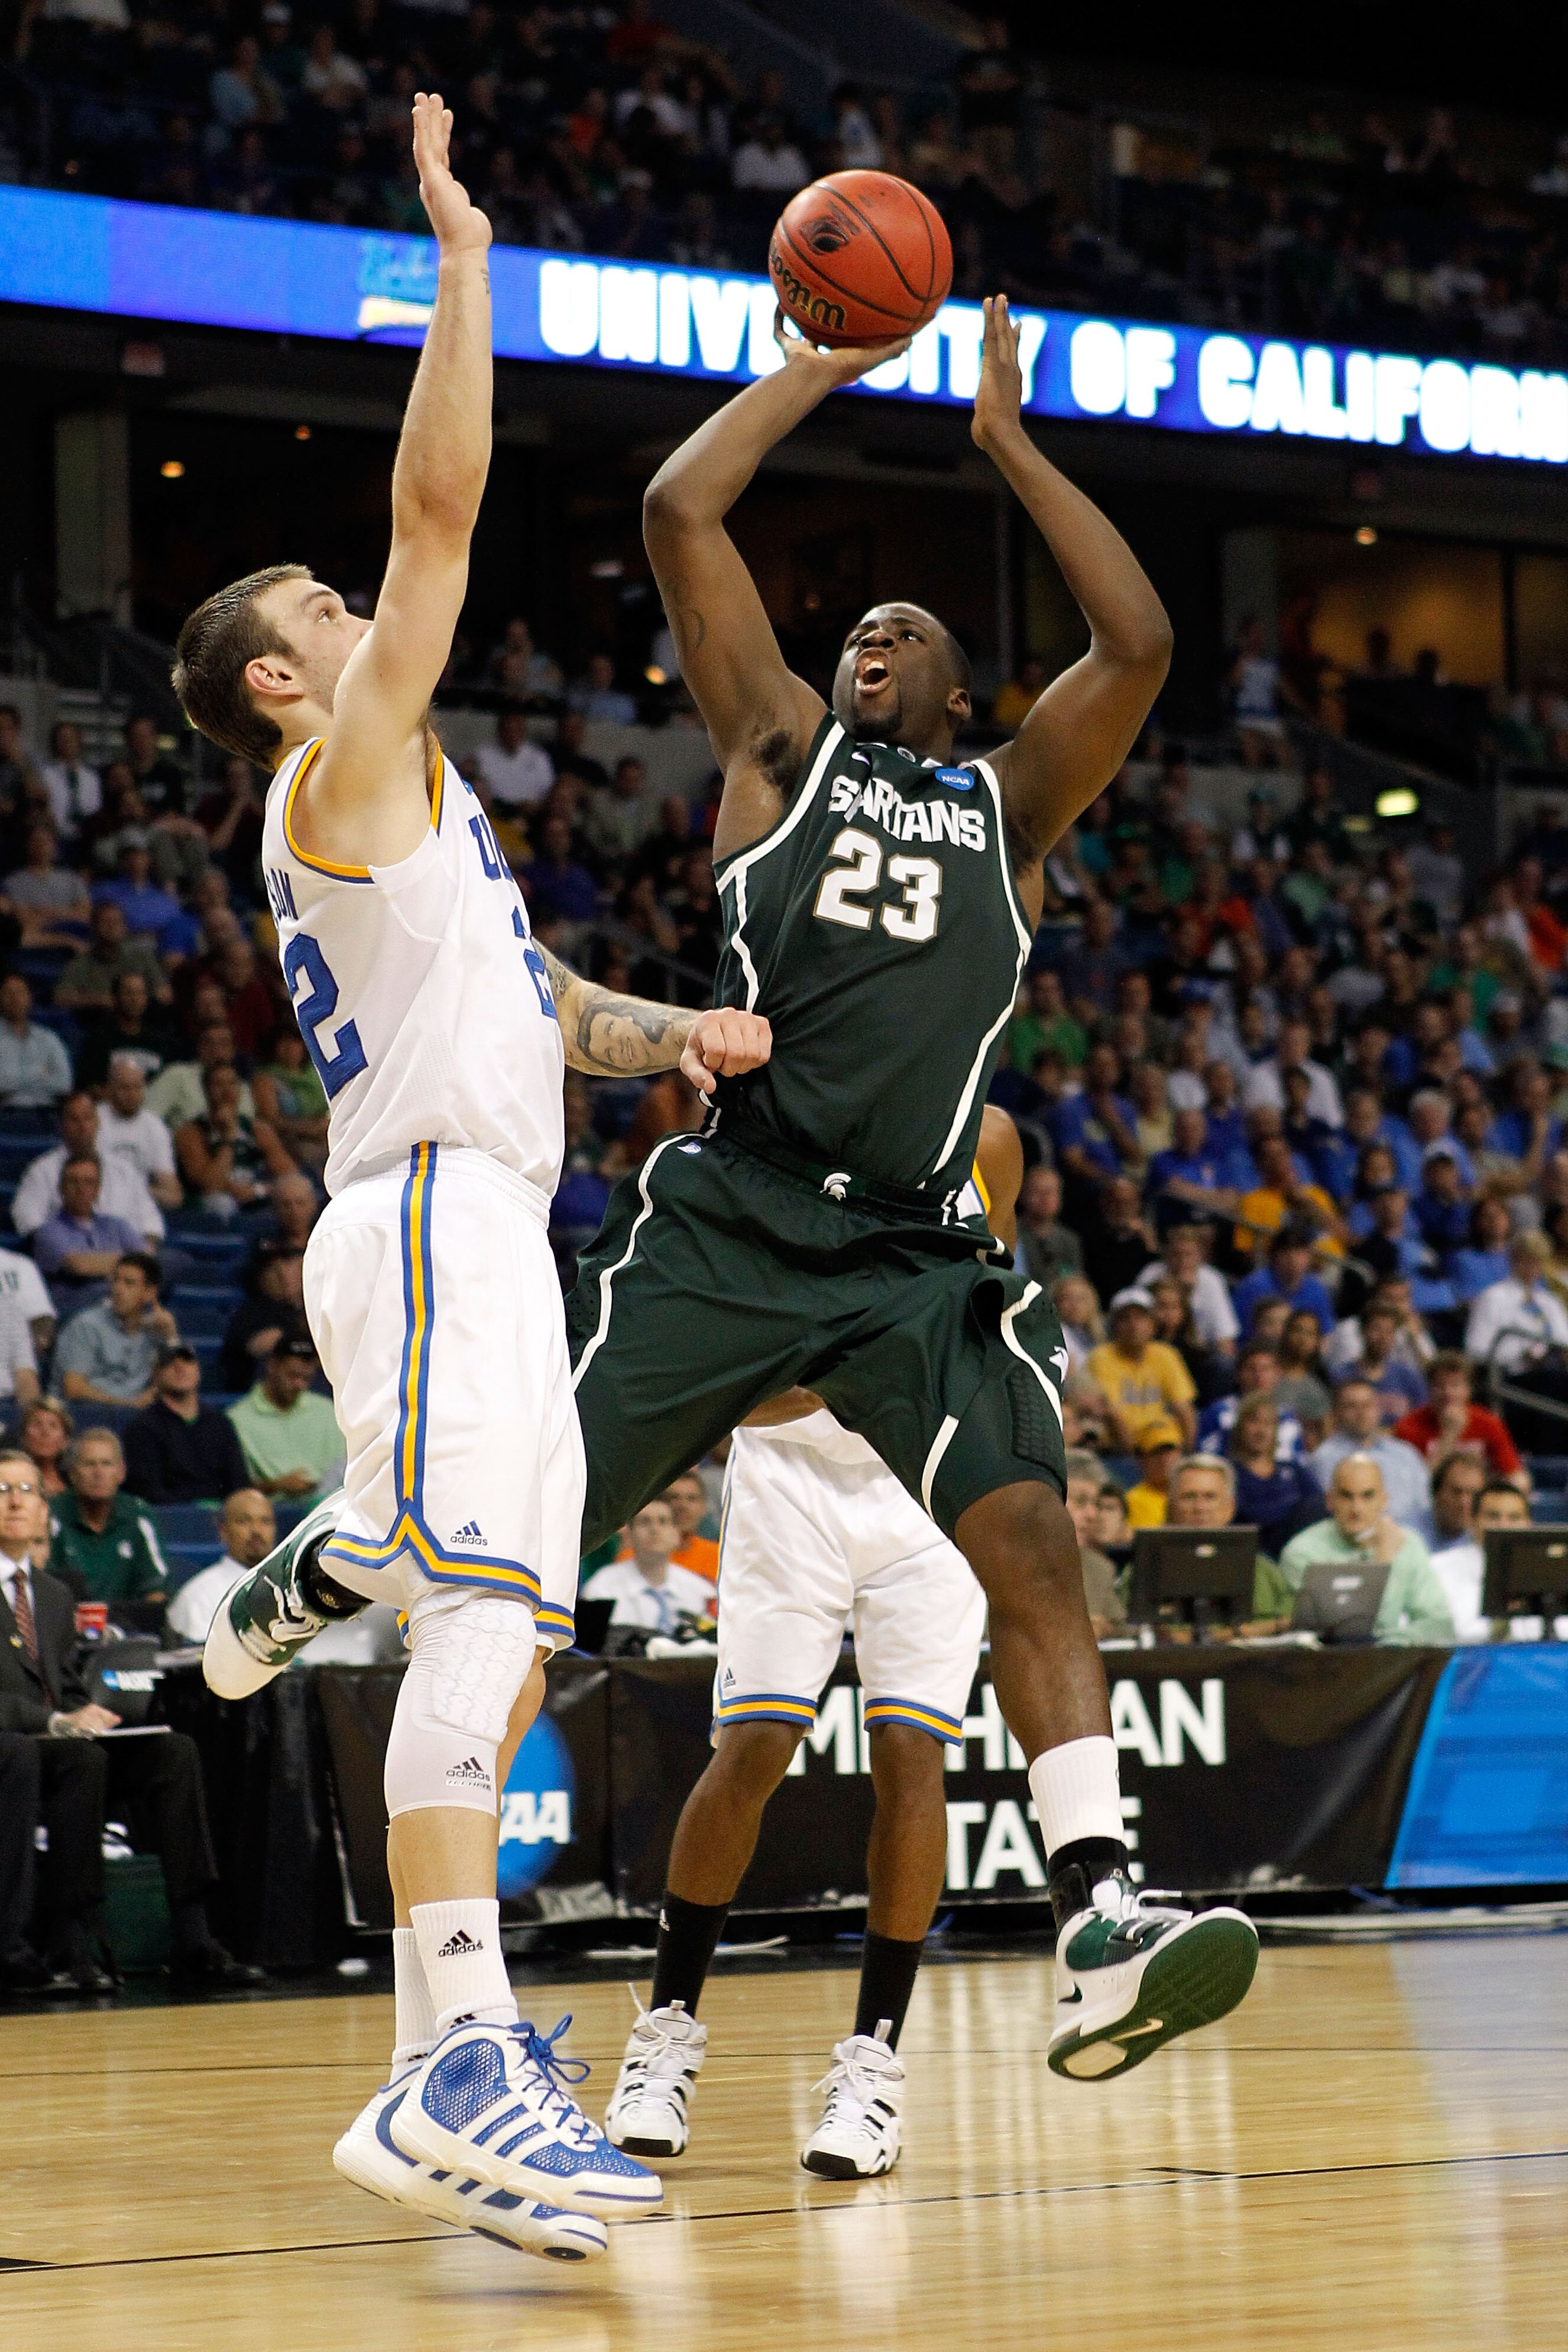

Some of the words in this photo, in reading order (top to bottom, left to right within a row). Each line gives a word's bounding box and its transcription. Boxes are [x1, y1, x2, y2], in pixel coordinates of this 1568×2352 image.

[771, 251, 845, 331] Wilso
[1071, 322, 1175, 417] OF
[941, 775, 970, 786] NCAA
[814, 827, 942, 943] 23
[450, 1535, 488, 1546] adidas
[446, 1769, 490, 1781] adidas
[438, 1940, 484, 1958] adidas
